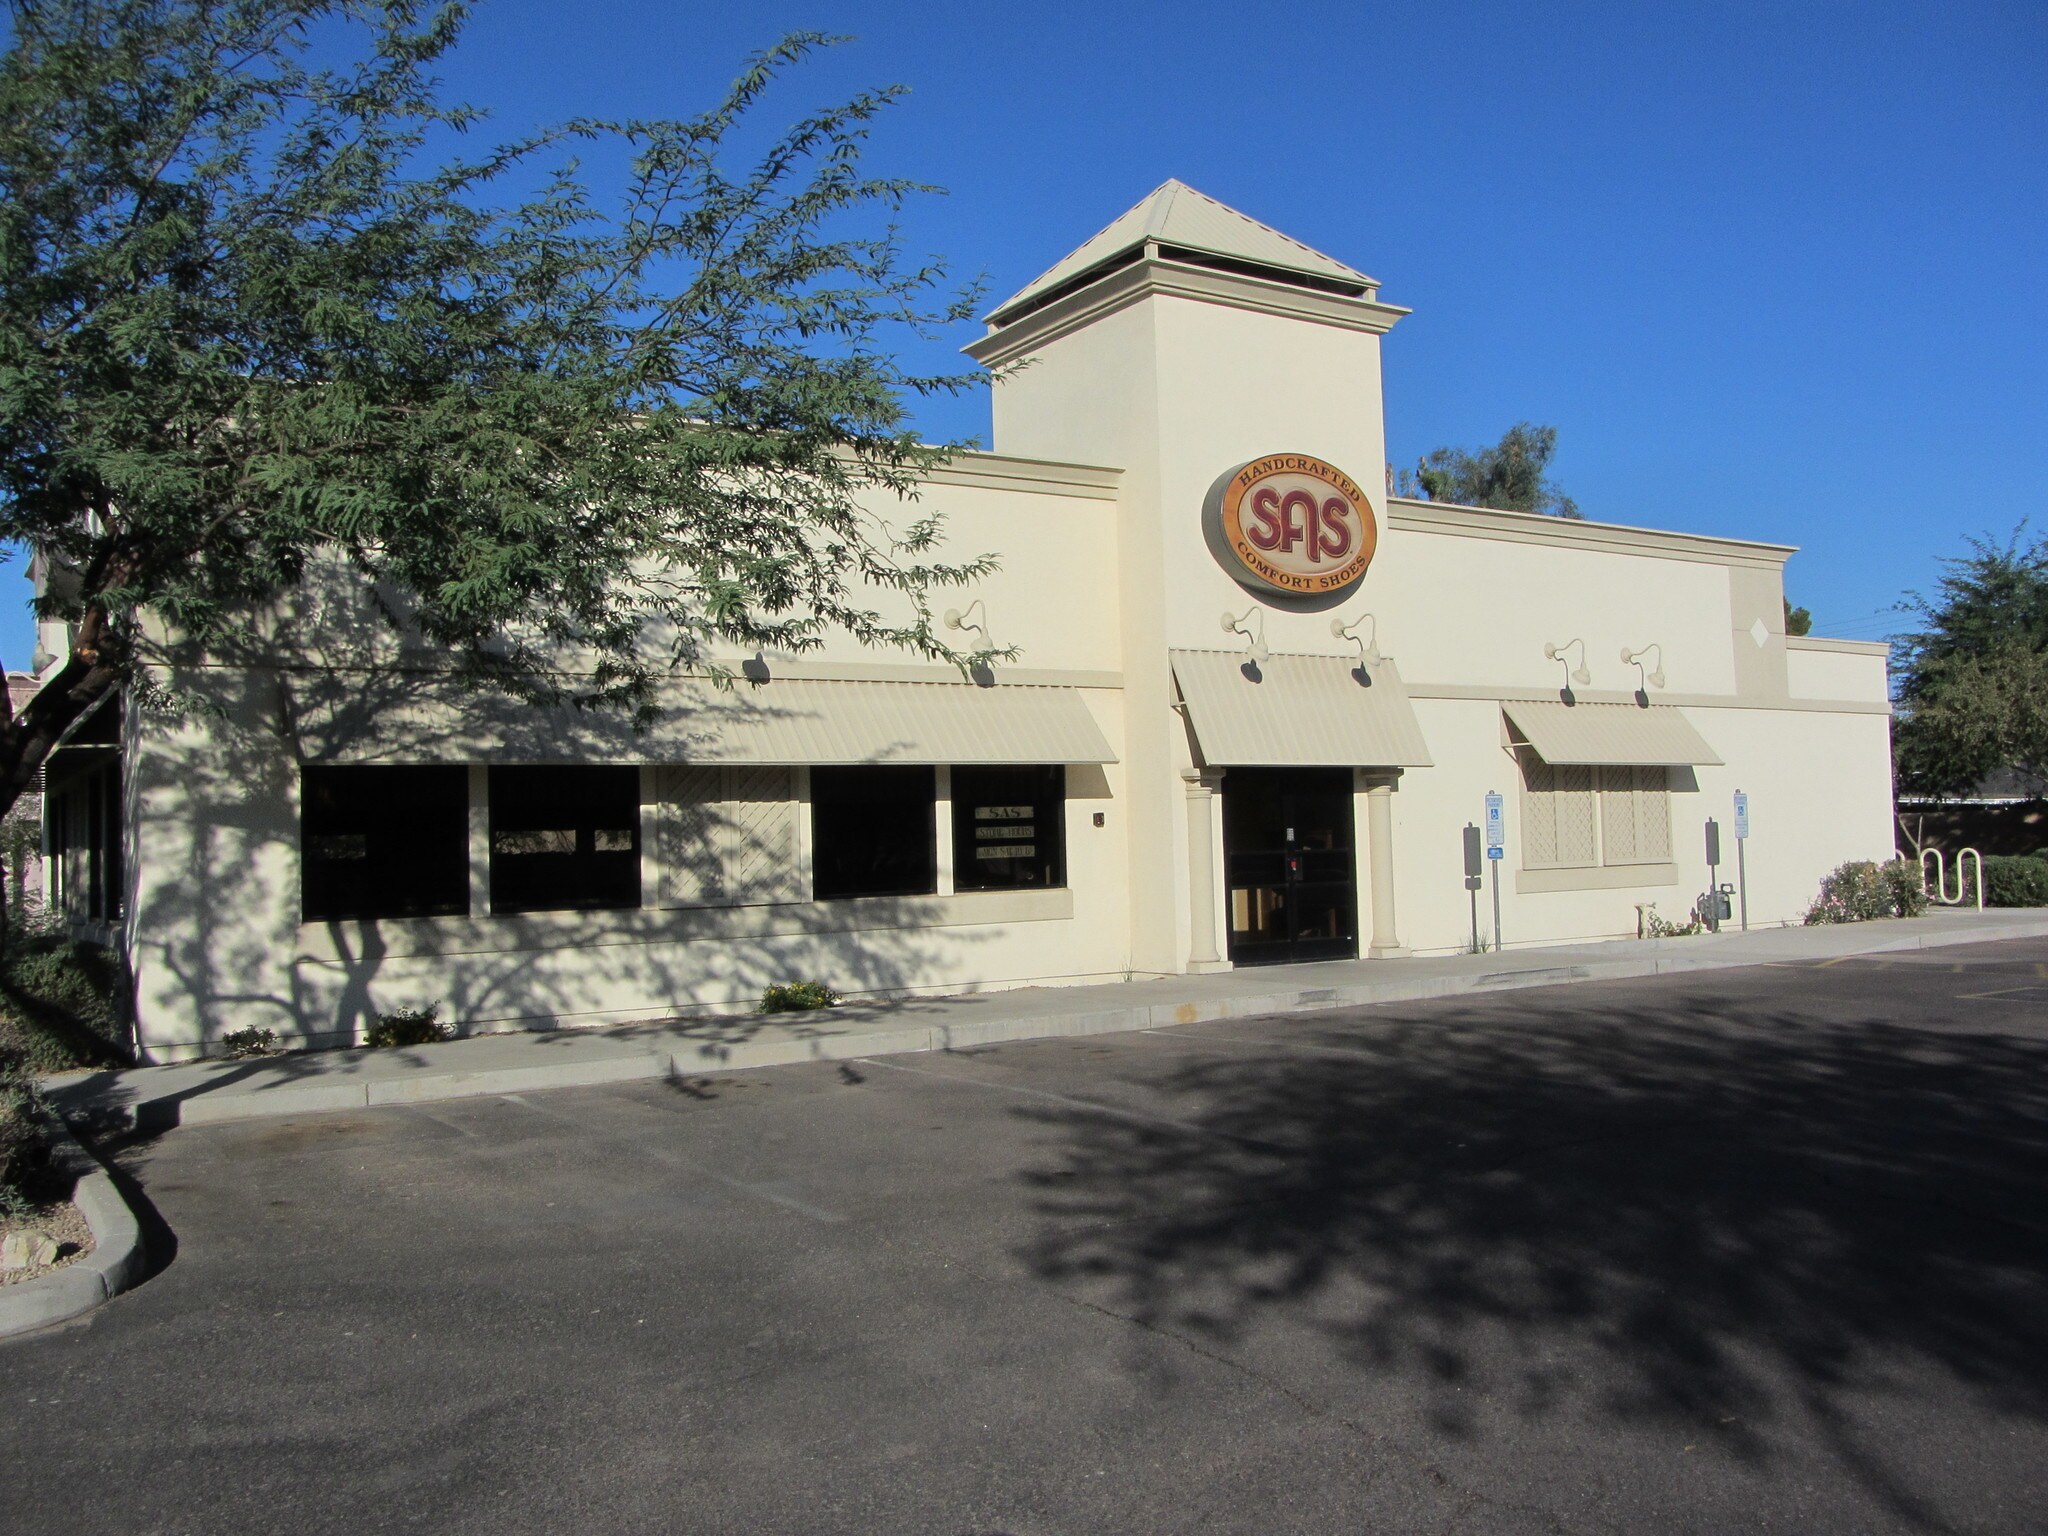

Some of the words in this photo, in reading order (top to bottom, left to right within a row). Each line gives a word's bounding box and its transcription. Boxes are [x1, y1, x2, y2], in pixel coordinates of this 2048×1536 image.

[1239, 457, 1360, 503] HANDCRAFTED
[1246, 486, 1352, 563] SAS
[1237, 541, 1313, 589] COMFORT
[1320, 555, 1366, 589] SHOES
[989, 807, 1021, 818] SAS
